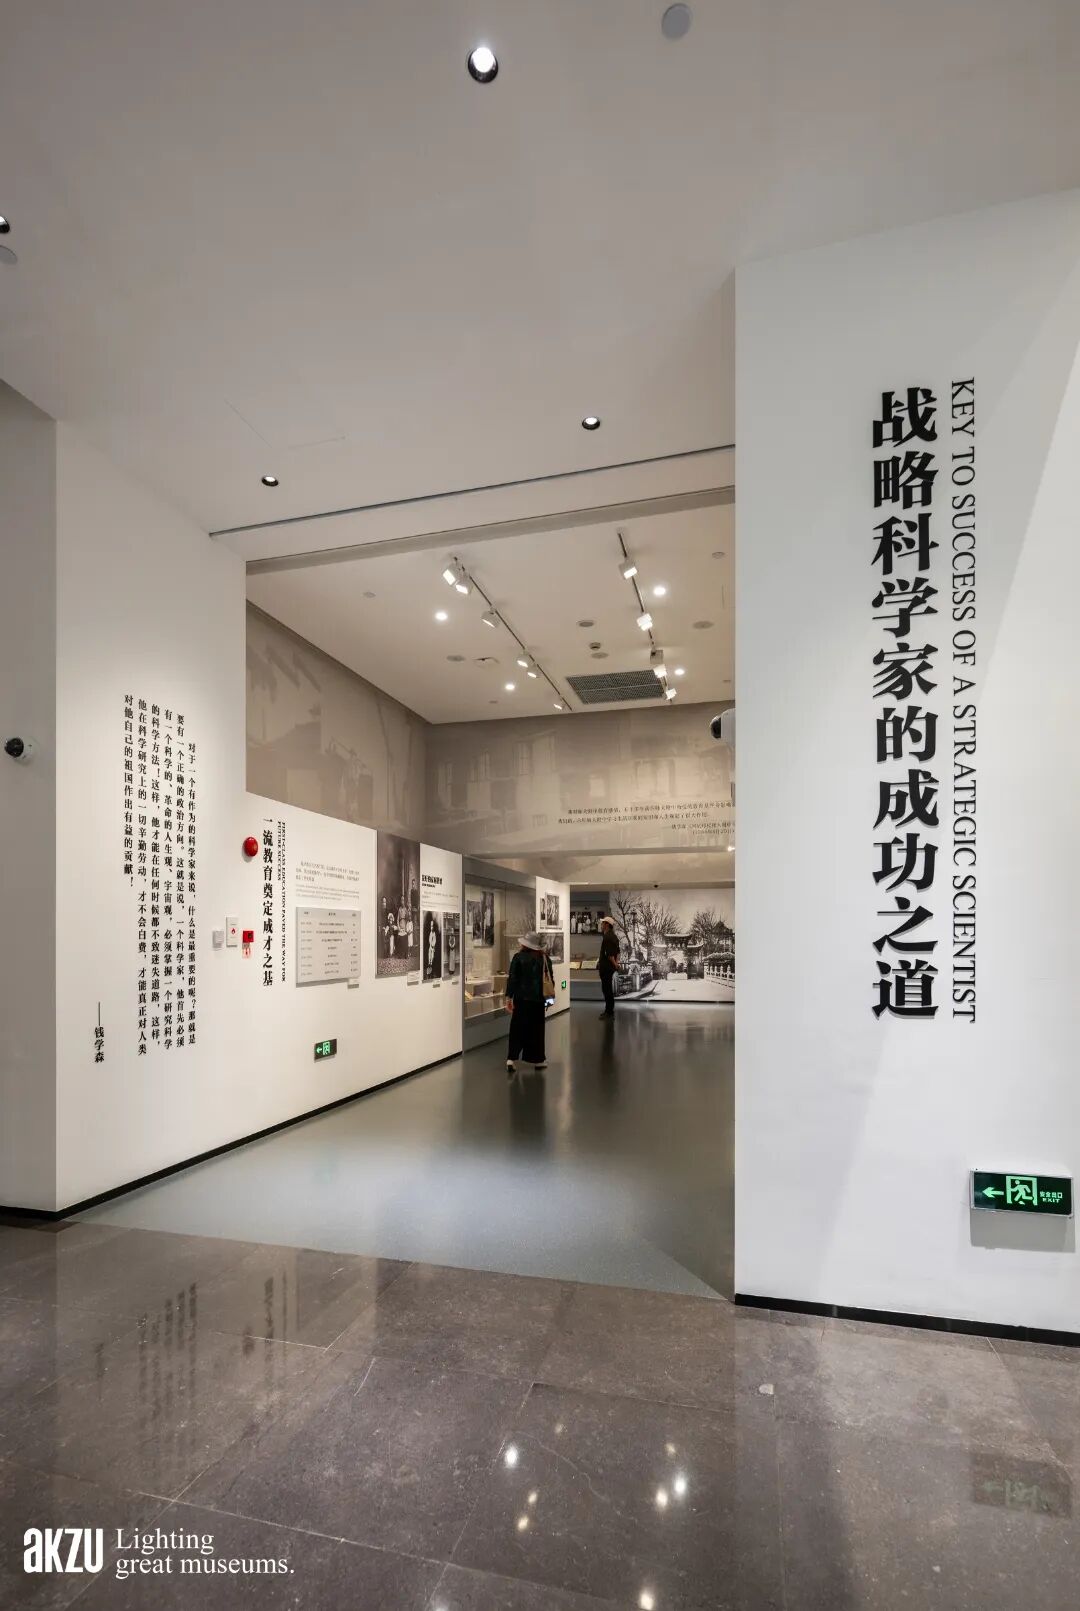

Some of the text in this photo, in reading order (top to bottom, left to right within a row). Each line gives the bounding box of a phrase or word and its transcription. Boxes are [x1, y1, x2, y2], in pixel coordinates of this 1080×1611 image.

[871, 386, 940, 1020] 战略科学家的成功之道
[951, 376, 977, 1024] KEY TO SUCCESS OF A STRATEGIC SCIENTIST
[262, 818, 273, 987] 一流教育奠定成才之基
[1039, 1191, 1063, 1199] 安全出口
